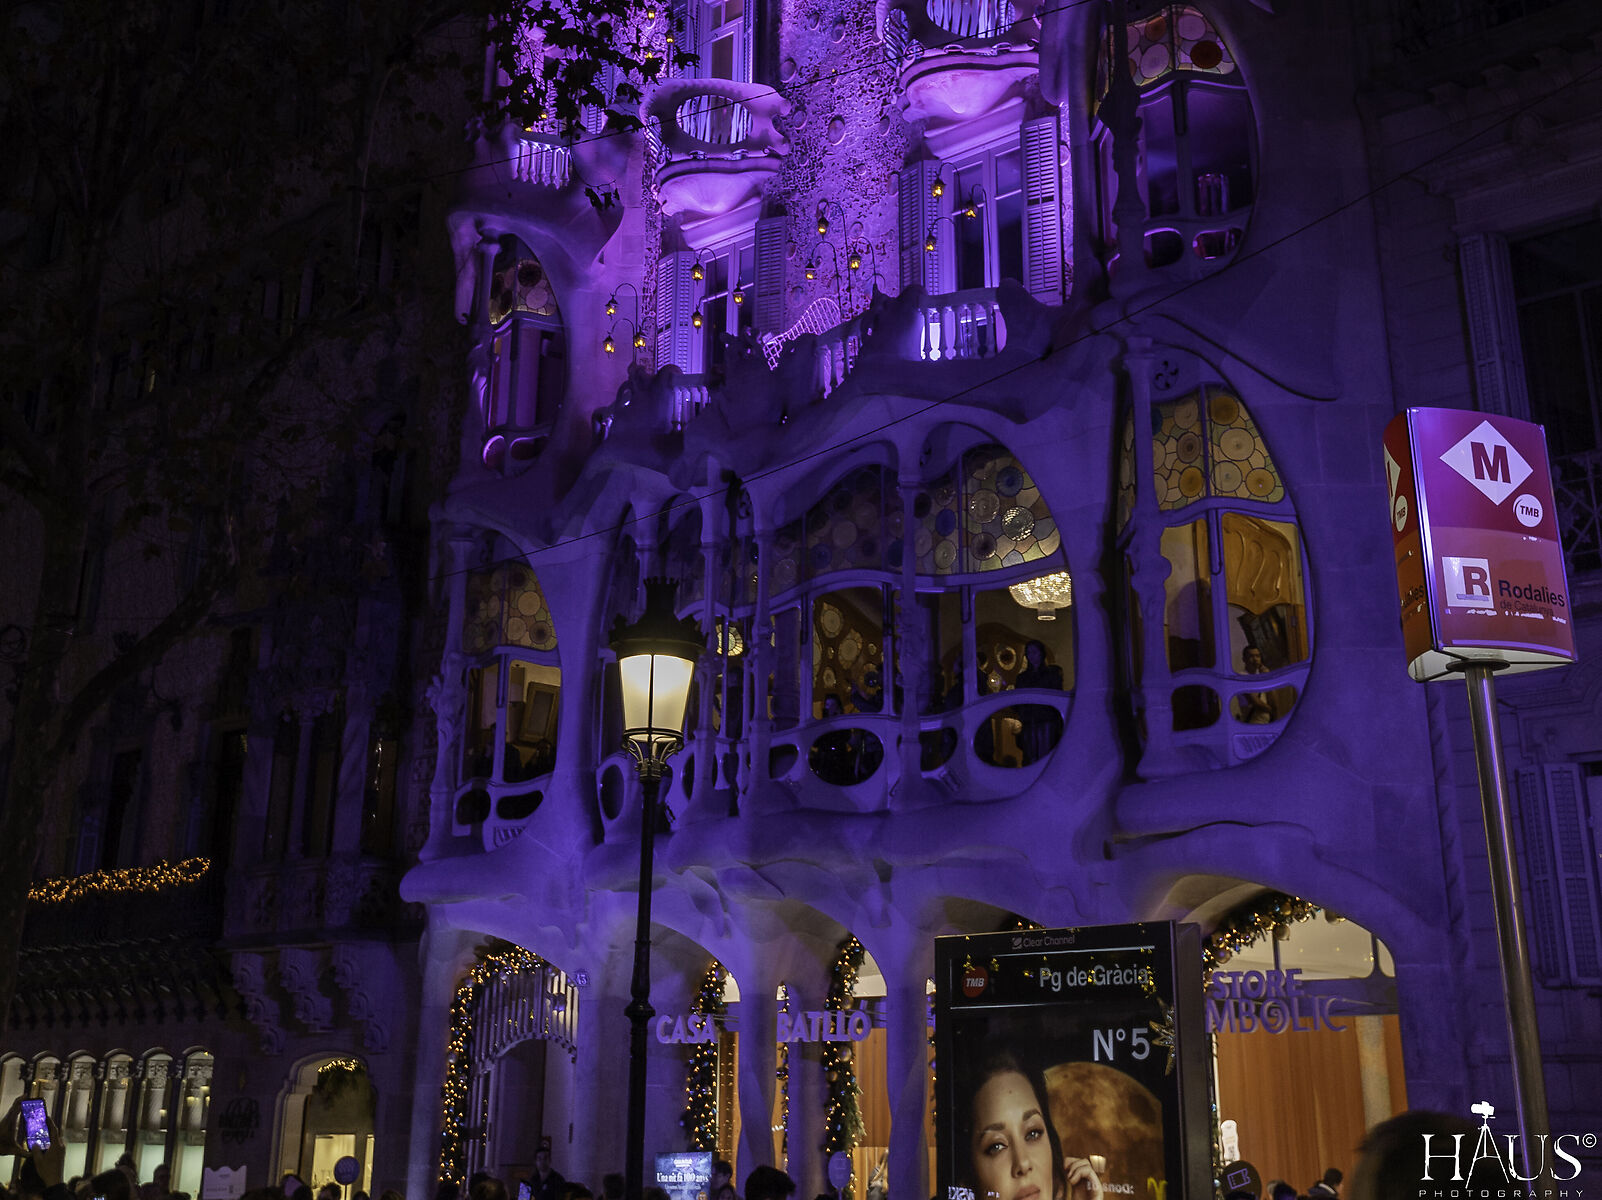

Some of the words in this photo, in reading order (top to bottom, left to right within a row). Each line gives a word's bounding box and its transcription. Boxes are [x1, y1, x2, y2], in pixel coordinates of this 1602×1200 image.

[1470, 441, 1512, 484] M
[1519, 504, 1540, 518] TMB
[1462, 565, 1491, 596] R
[1498, 579, 1566, 607] Rodalies
[1023, 937, 1043, 948] Clear
[1044, 935, 1076, 946] Channel
[966, 977, 985, 988] TMB
[1039, 966, 1062, 992] Pg
[1066, 965, 1088, 987] de
[1093, 963, 1149, 987] Gràcia
[1212, 968, 1306, 1000] STORE
[656, 1013, 719, 1044] CASA
[776, 999, 872, 1043] BATLLÓ
[1205, 995, 1349, 1035] MBOLIC
